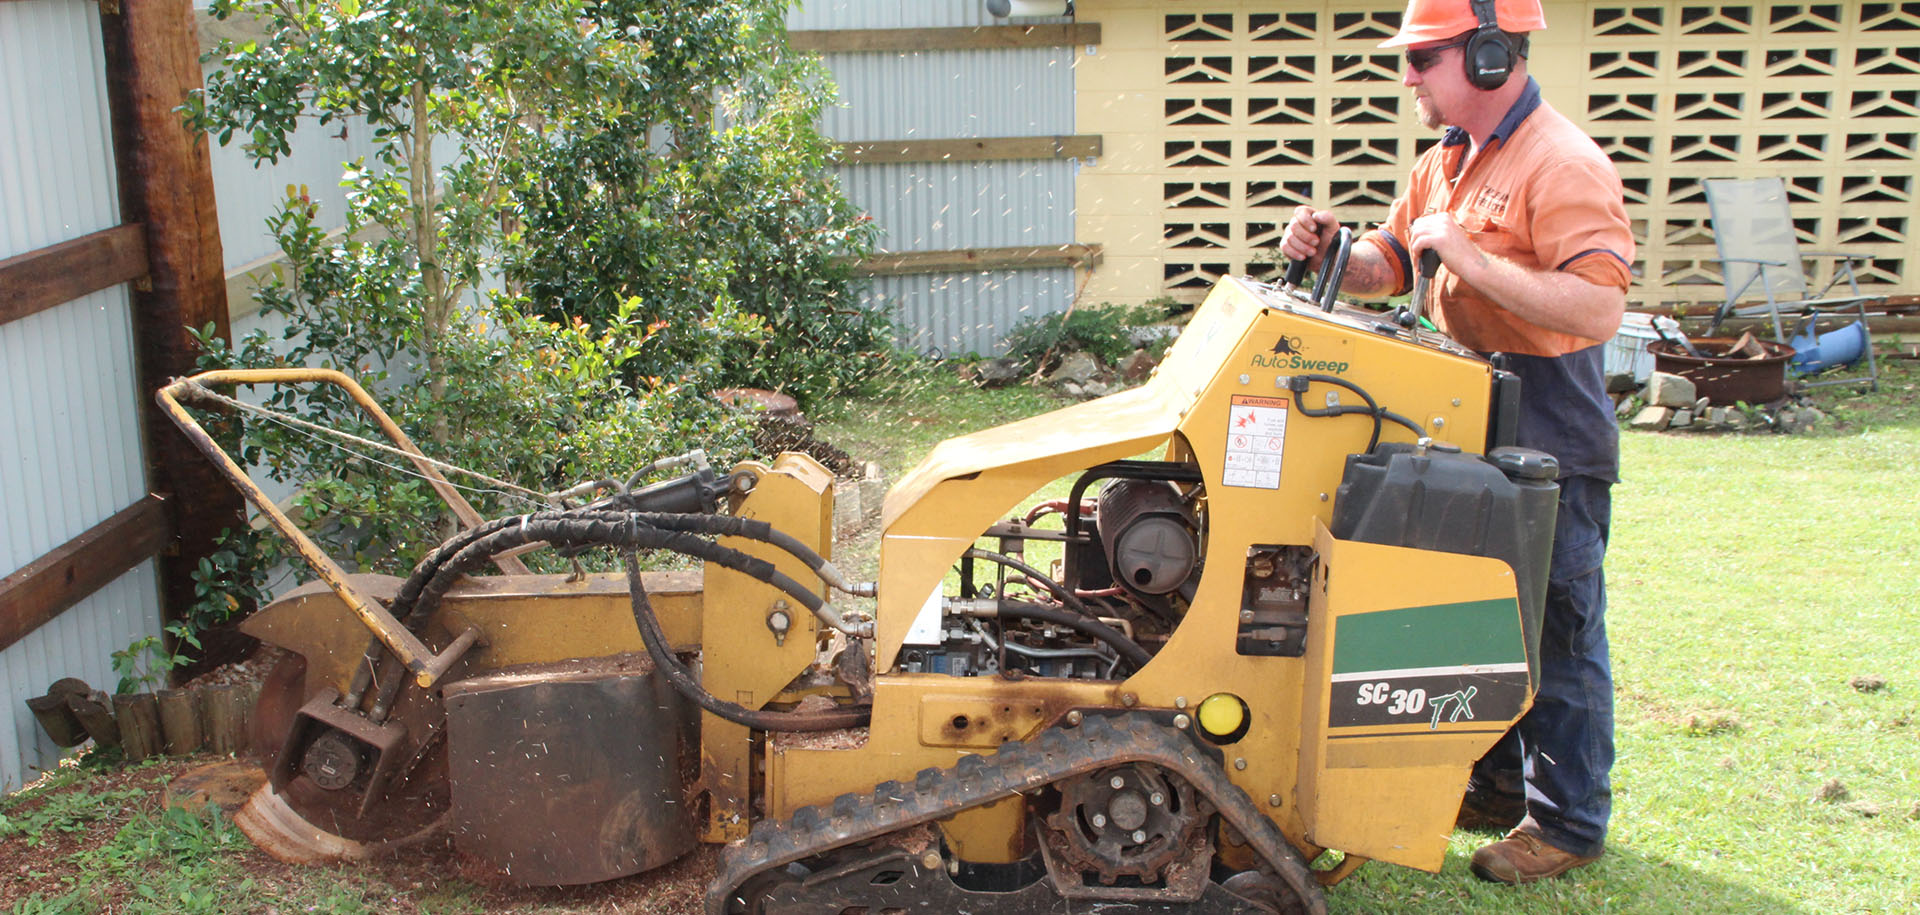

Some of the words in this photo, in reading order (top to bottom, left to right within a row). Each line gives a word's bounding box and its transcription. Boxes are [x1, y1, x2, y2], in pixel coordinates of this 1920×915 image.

[1250, 354, 1349, 374] AutoSweep
[1247, 398, 1281, 407] WARNING
[1428, 685, 1478, 730] TX
